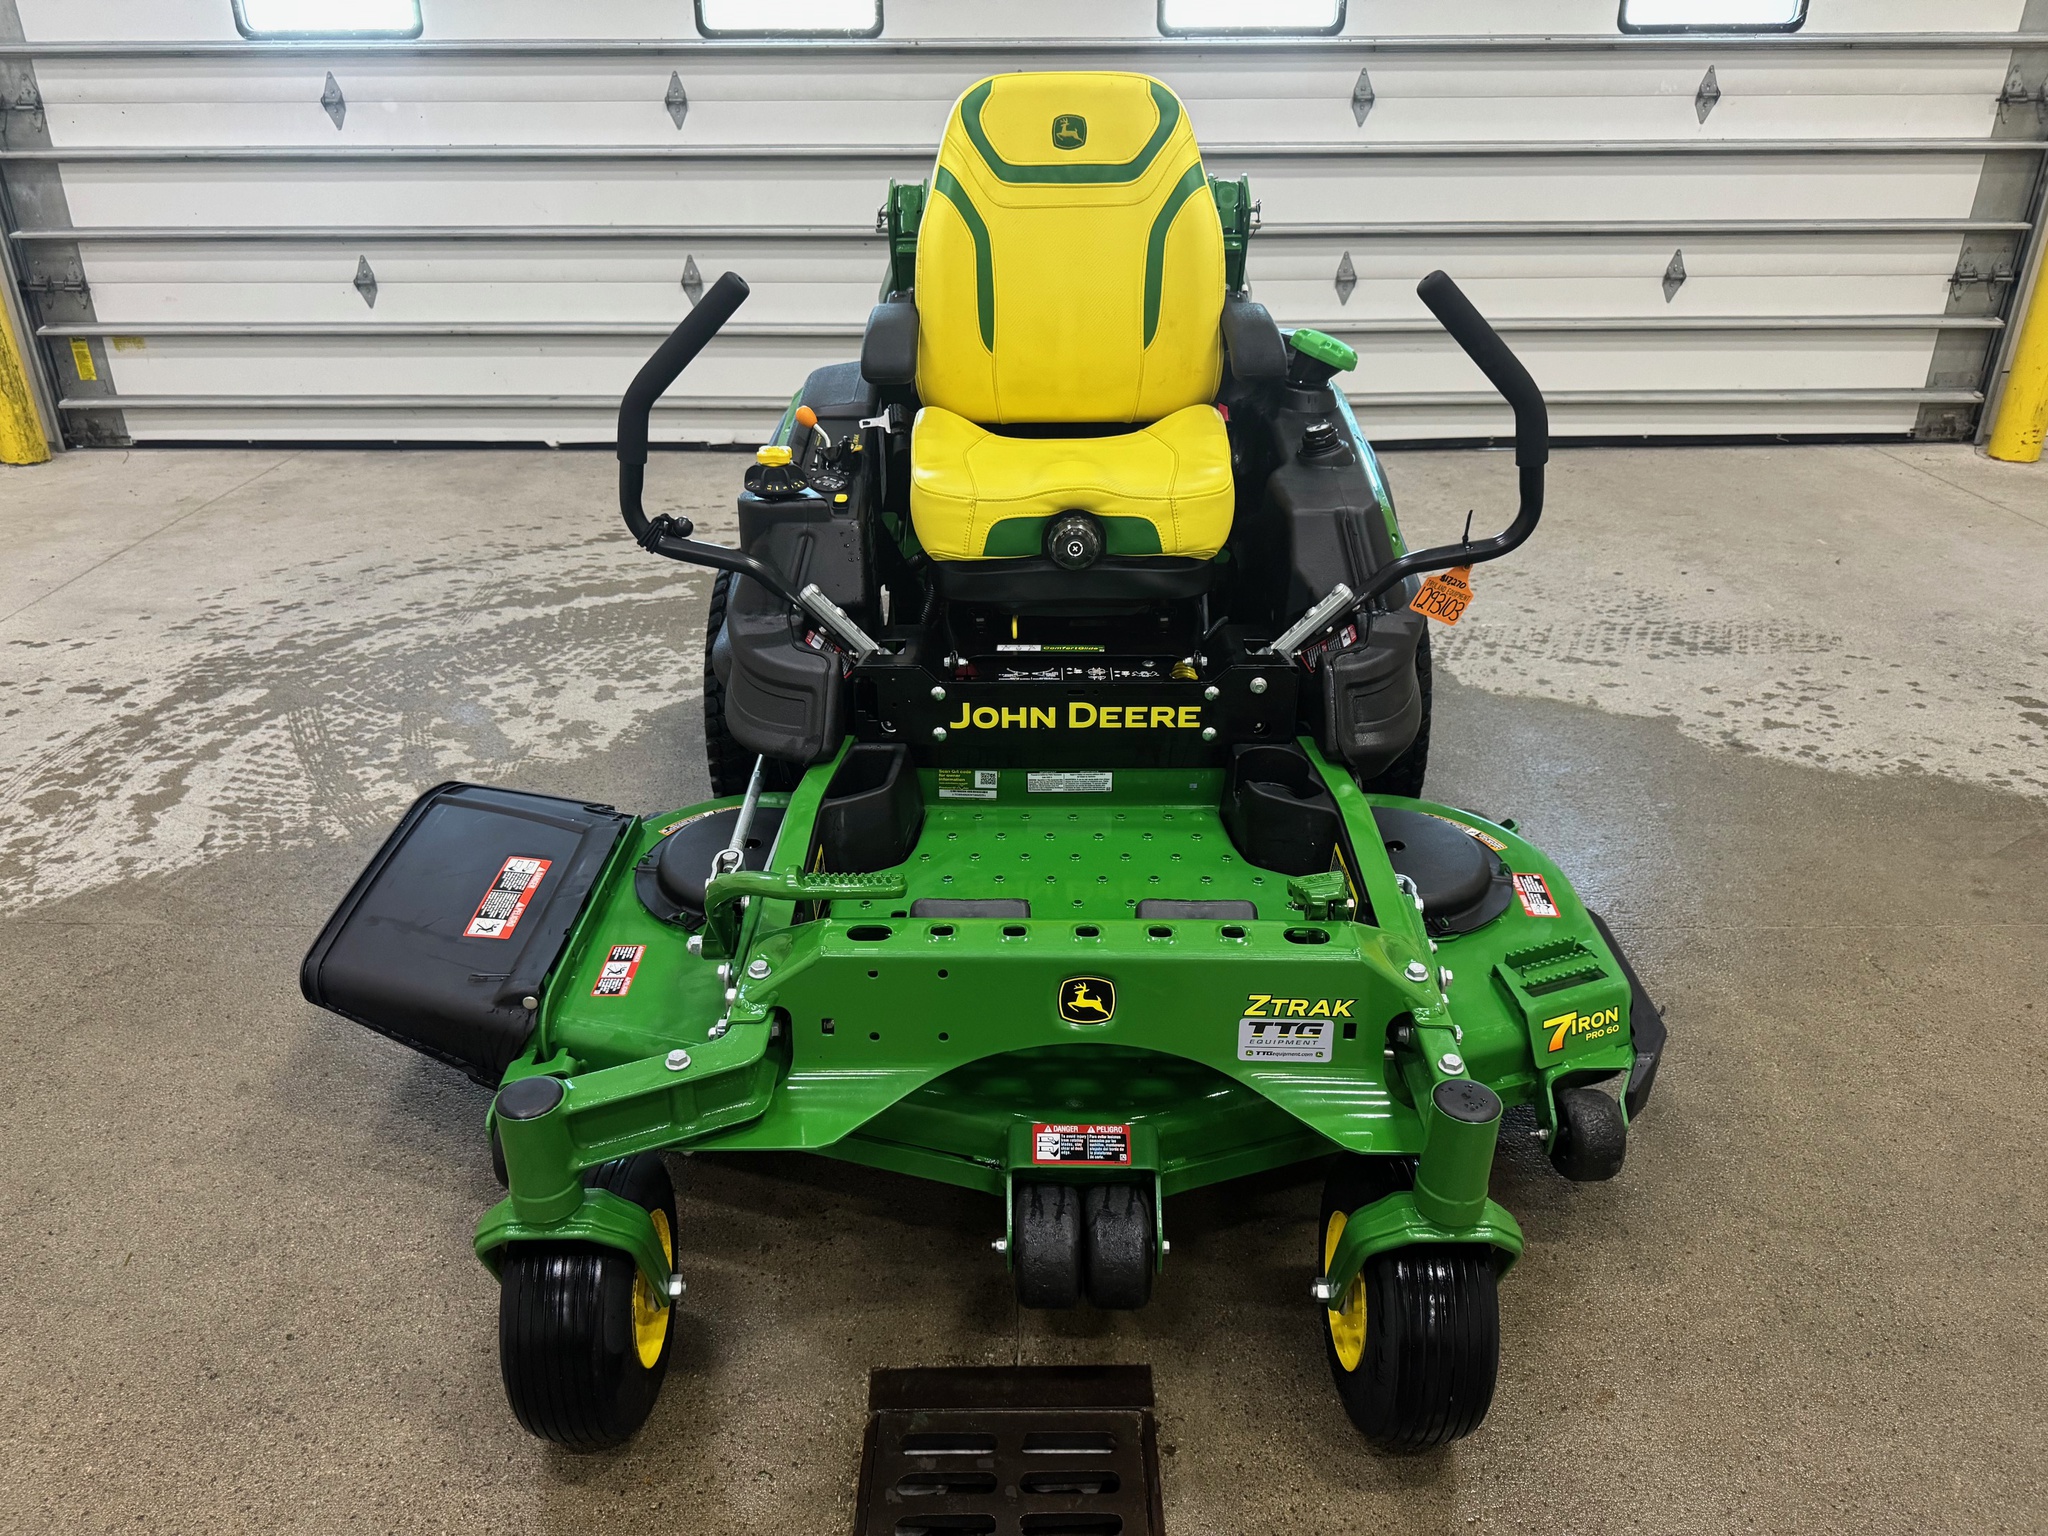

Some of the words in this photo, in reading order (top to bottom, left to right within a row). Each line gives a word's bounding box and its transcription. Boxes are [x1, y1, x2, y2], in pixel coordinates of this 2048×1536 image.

[1413, 586, 1465, 622] 1293103
[949, 702, 1056, 729] JOHN
[1068, 702, 1202, 729] DEERE
[1243, 993, 1357, 1018] ZTRAK
[1248, 1021, 1325, 1039] TTG
[1585, 1030, 1605, 1041] PRO
[1606, 1024, 1620, 1034] 60
[1256, 1050, 1314, 1058] TTGequipment.com
